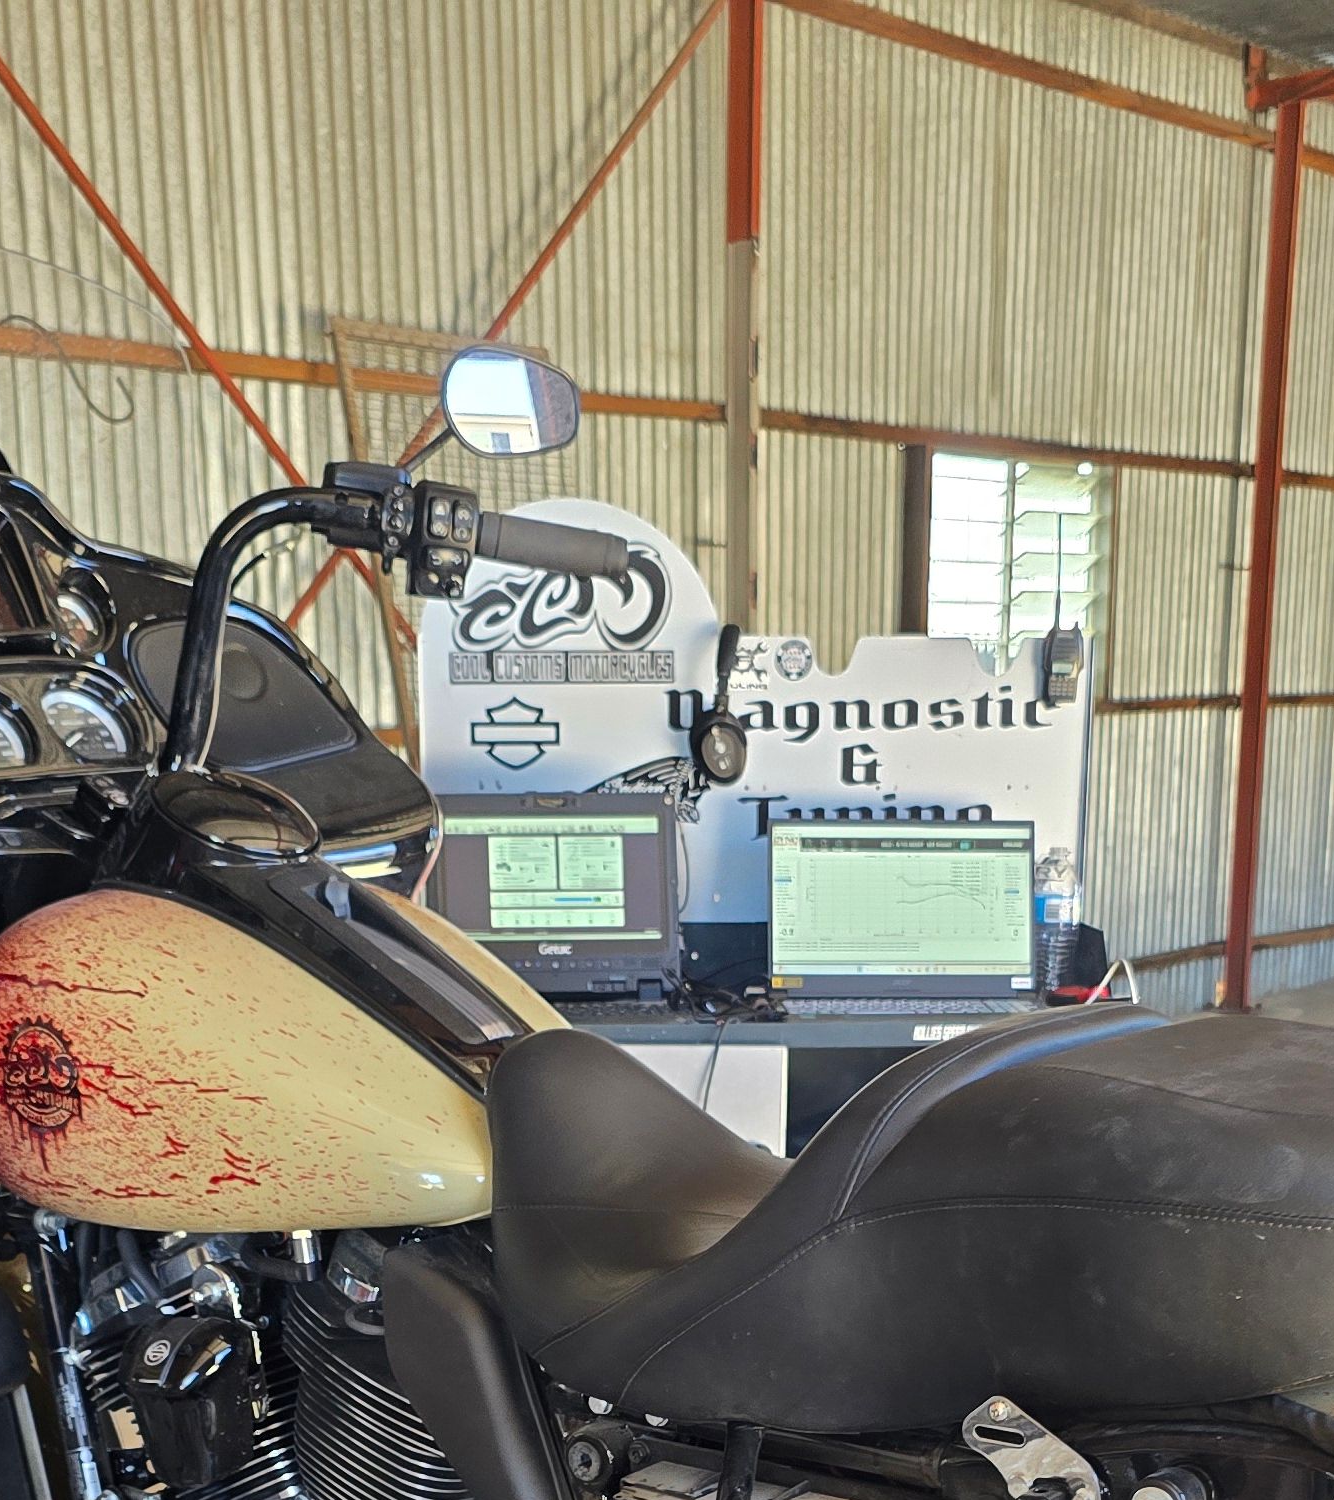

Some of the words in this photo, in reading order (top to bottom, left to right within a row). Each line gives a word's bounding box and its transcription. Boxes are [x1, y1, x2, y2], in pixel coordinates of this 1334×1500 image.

[453, 653, 490, 681] COOL
[496, 653, 563, 681] CUSTOMS
[569, 653, 672, 682] MOTORCYCLES
[665, 685, 1059, 742] Dagnostic
[842, 743, 883, 784] &
